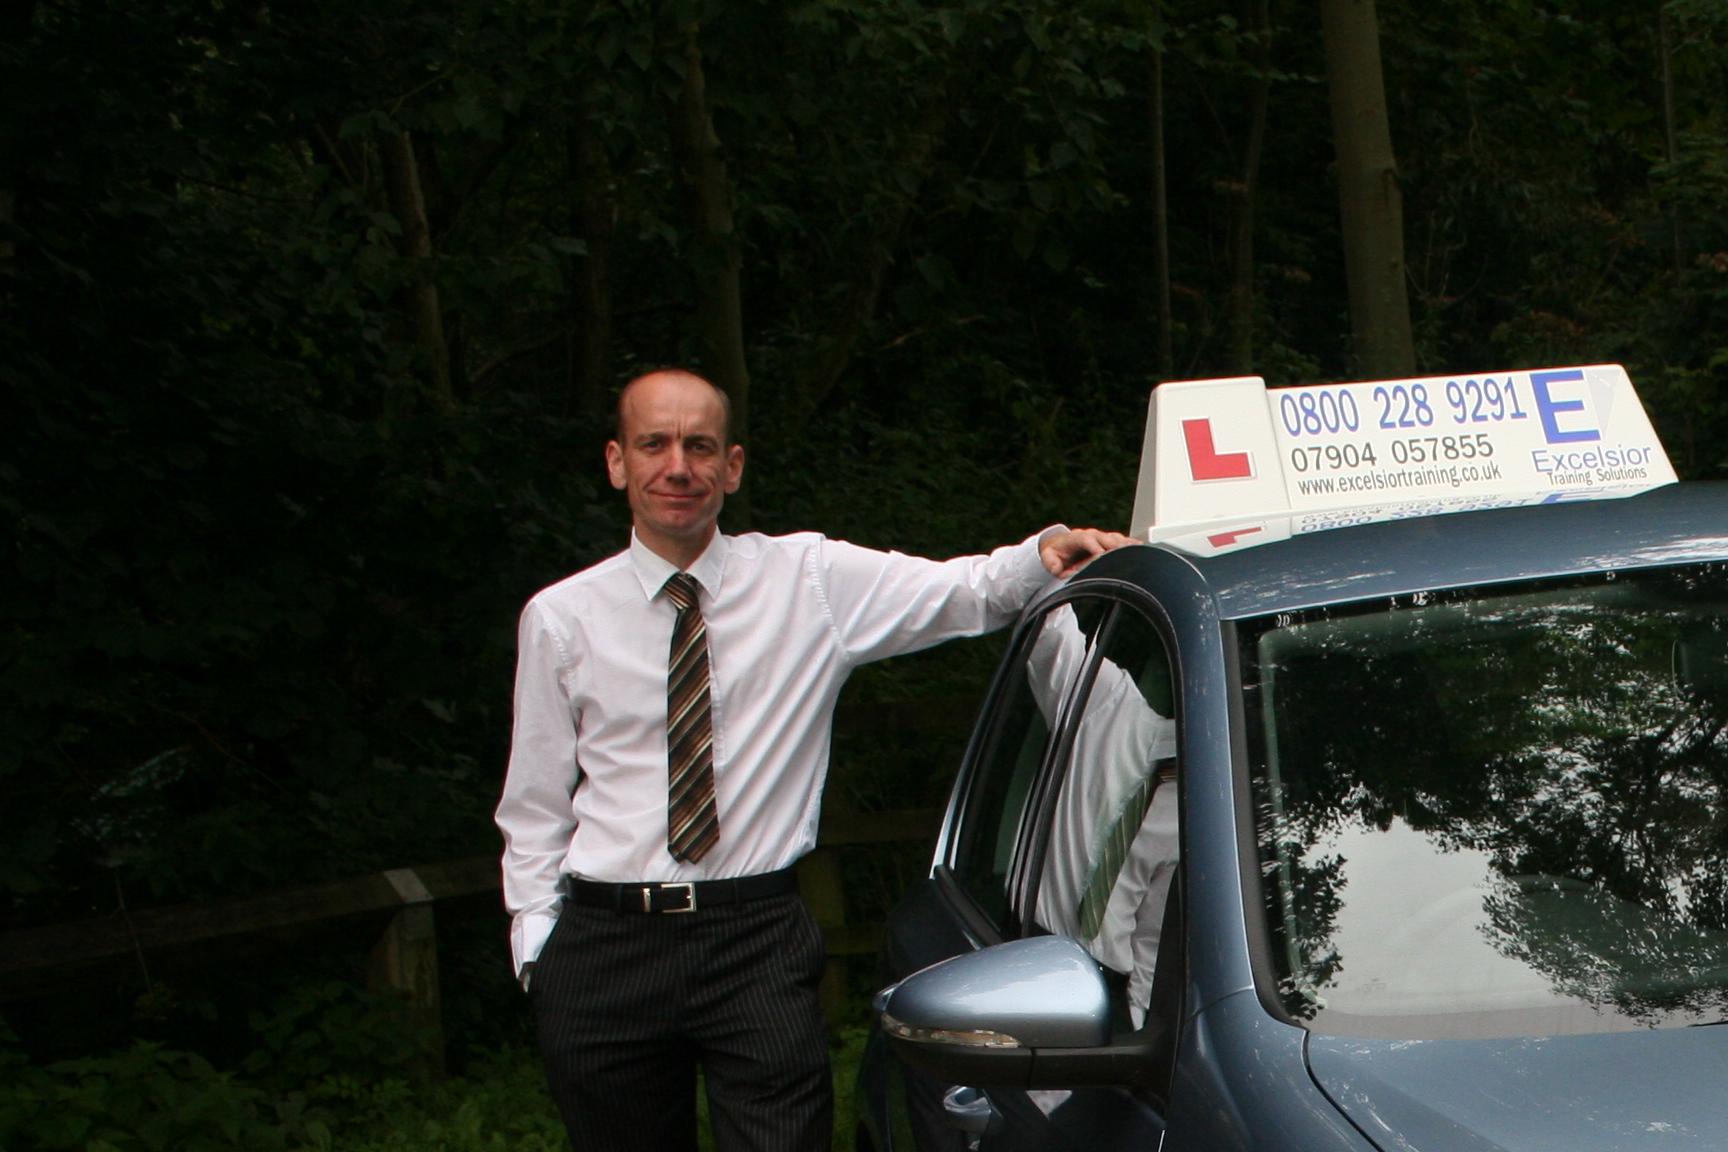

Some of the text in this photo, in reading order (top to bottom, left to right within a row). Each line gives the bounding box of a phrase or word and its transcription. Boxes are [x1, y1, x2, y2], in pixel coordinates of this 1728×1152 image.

[1280, 376, 1528, 437] 0800 228 9291
[1529, 370, 1602, 444] E
[1182, 418, 1252, 481] L
[1291, 433, 1494, 472] 07904 057855
[1531, 444, 1651, 473] Excelsior
[1298, 461, 1502, 495] www.excelsiortraining.co.uk
[1547, 466, 1648, 486] Training Solutions
